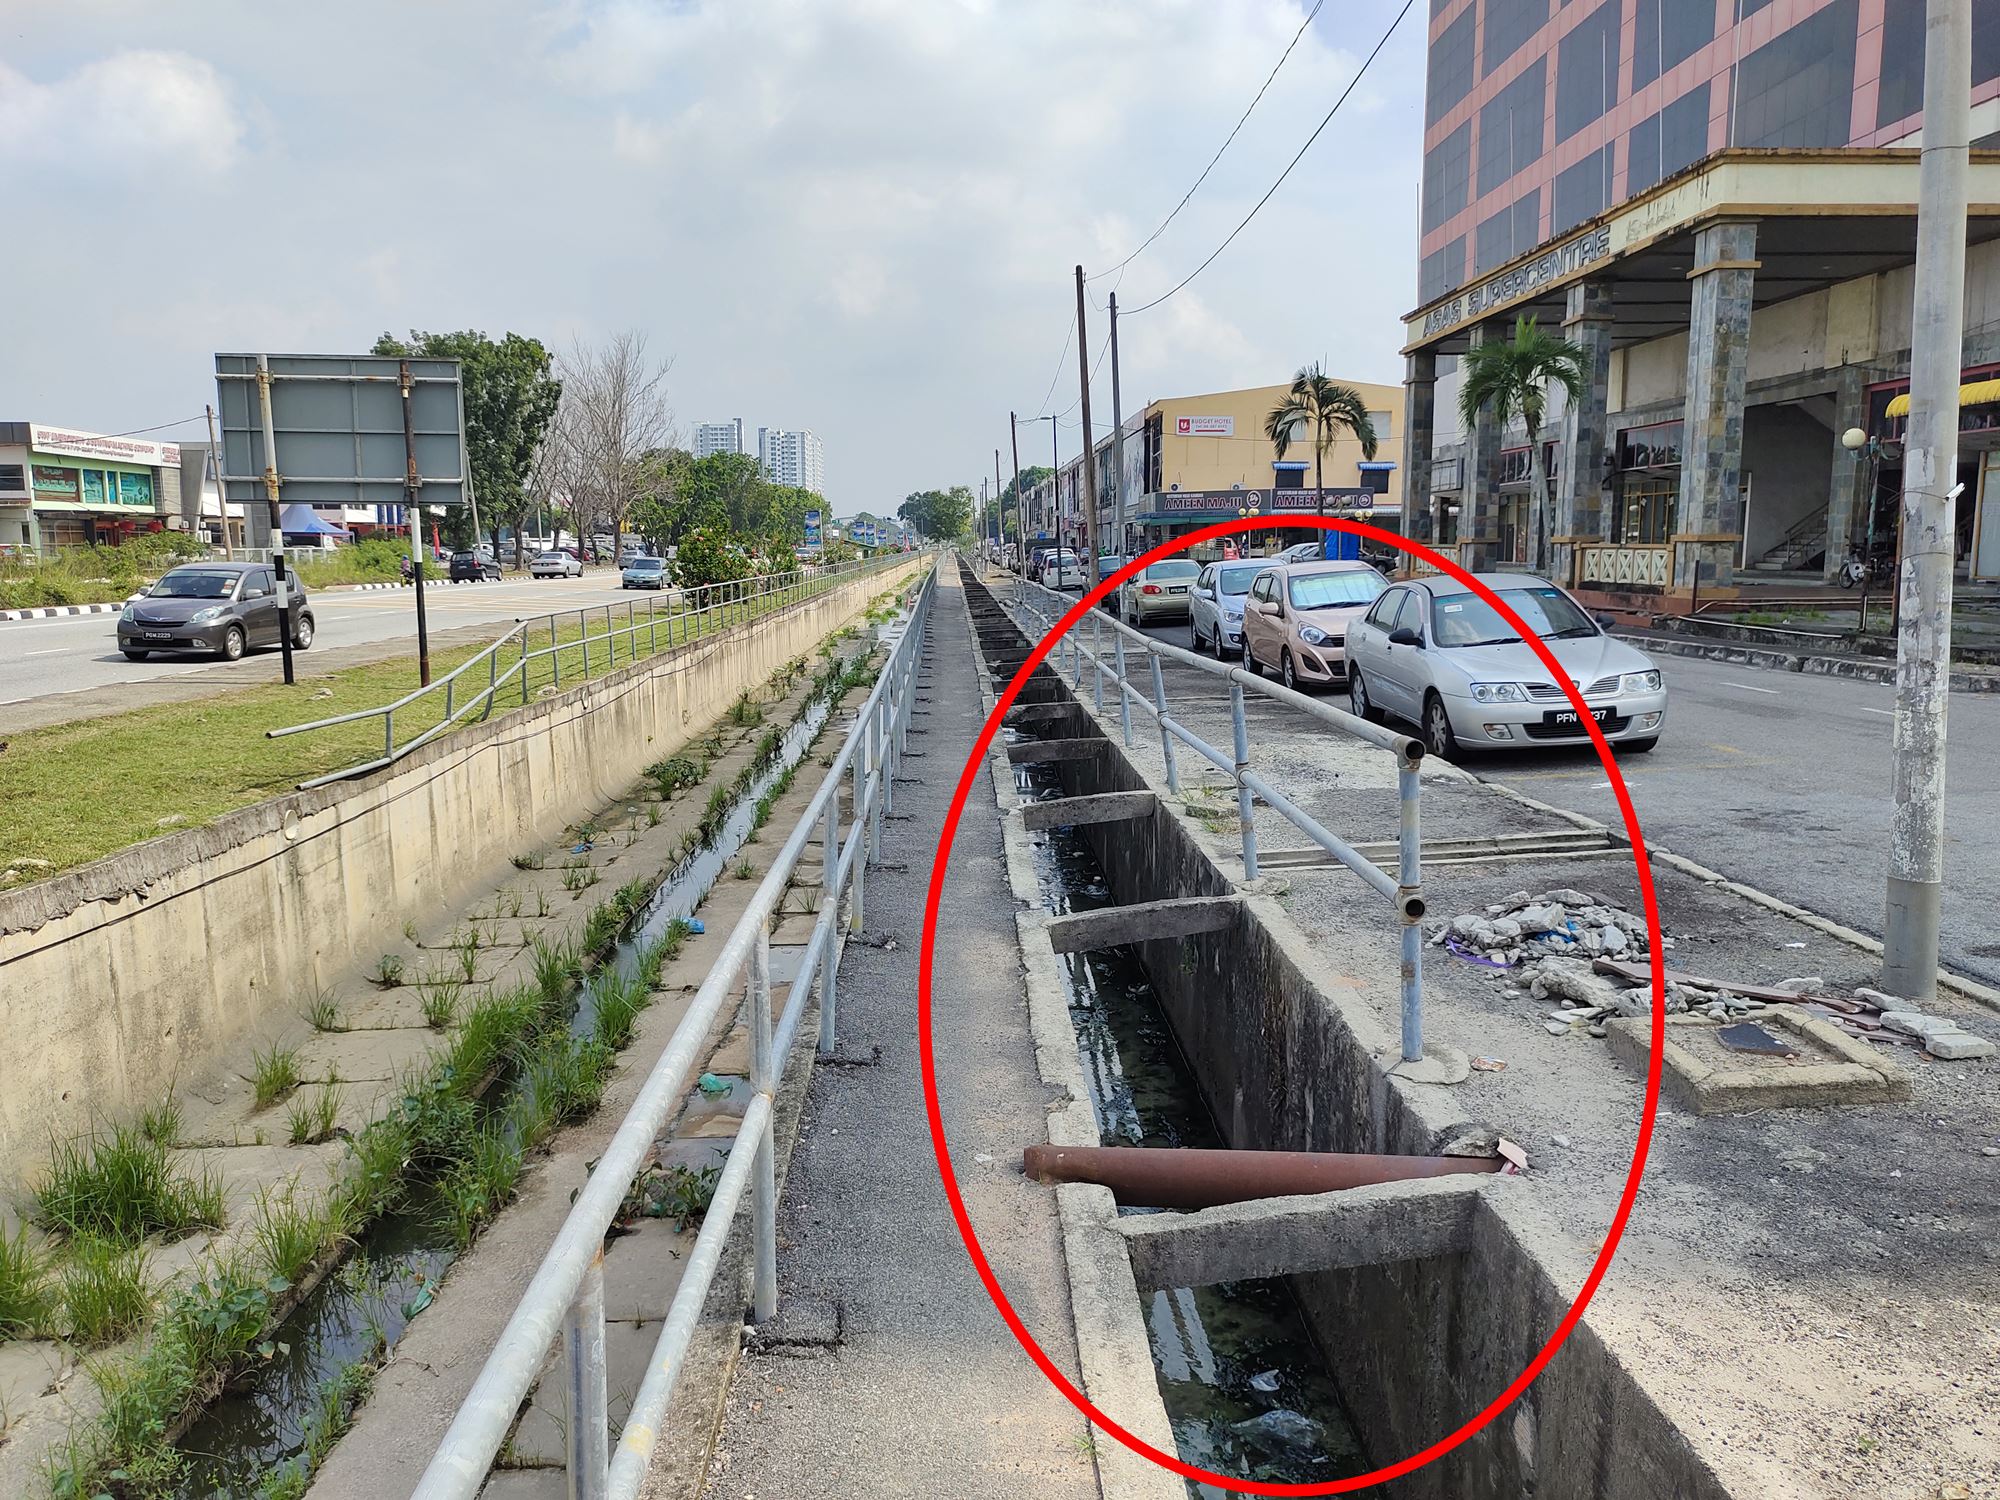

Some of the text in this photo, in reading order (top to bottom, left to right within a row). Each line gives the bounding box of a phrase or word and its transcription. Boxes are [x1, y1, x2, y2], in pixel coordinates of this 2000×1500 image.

[1423, 224, 1612, 338] ASAS SUPERCENTRE
[1164, 496, 1242, 510] AMEEN MAJU
[1275, 495, 1318, 507] AMEEN
[1556, 713, 1577, 724] PFN
